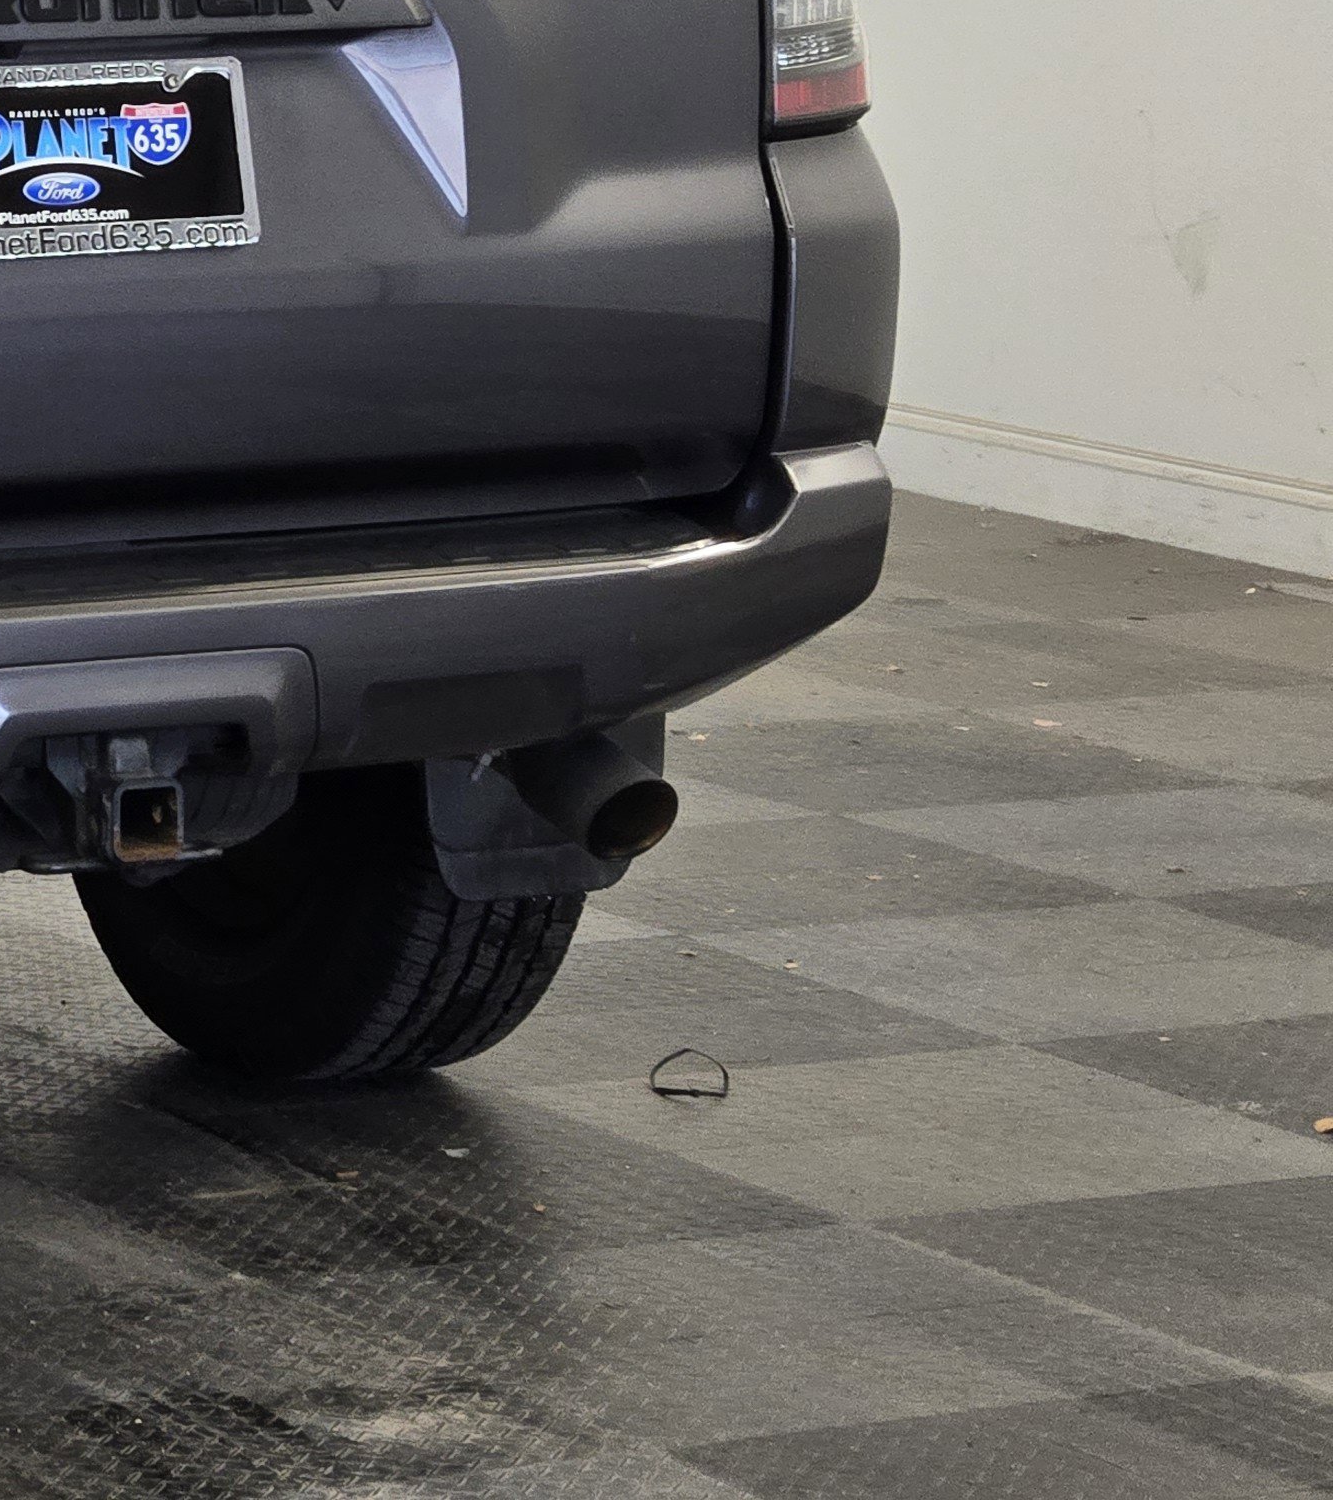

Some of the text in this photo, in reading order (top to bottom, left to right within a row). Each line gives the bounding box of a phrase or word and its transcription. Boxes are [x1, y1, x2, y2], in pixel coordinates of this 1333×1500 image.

[91, 62, 166, 79] REED'S
[134, 123, 181, 153] 635
[38, 179, 84, 200] Ford
